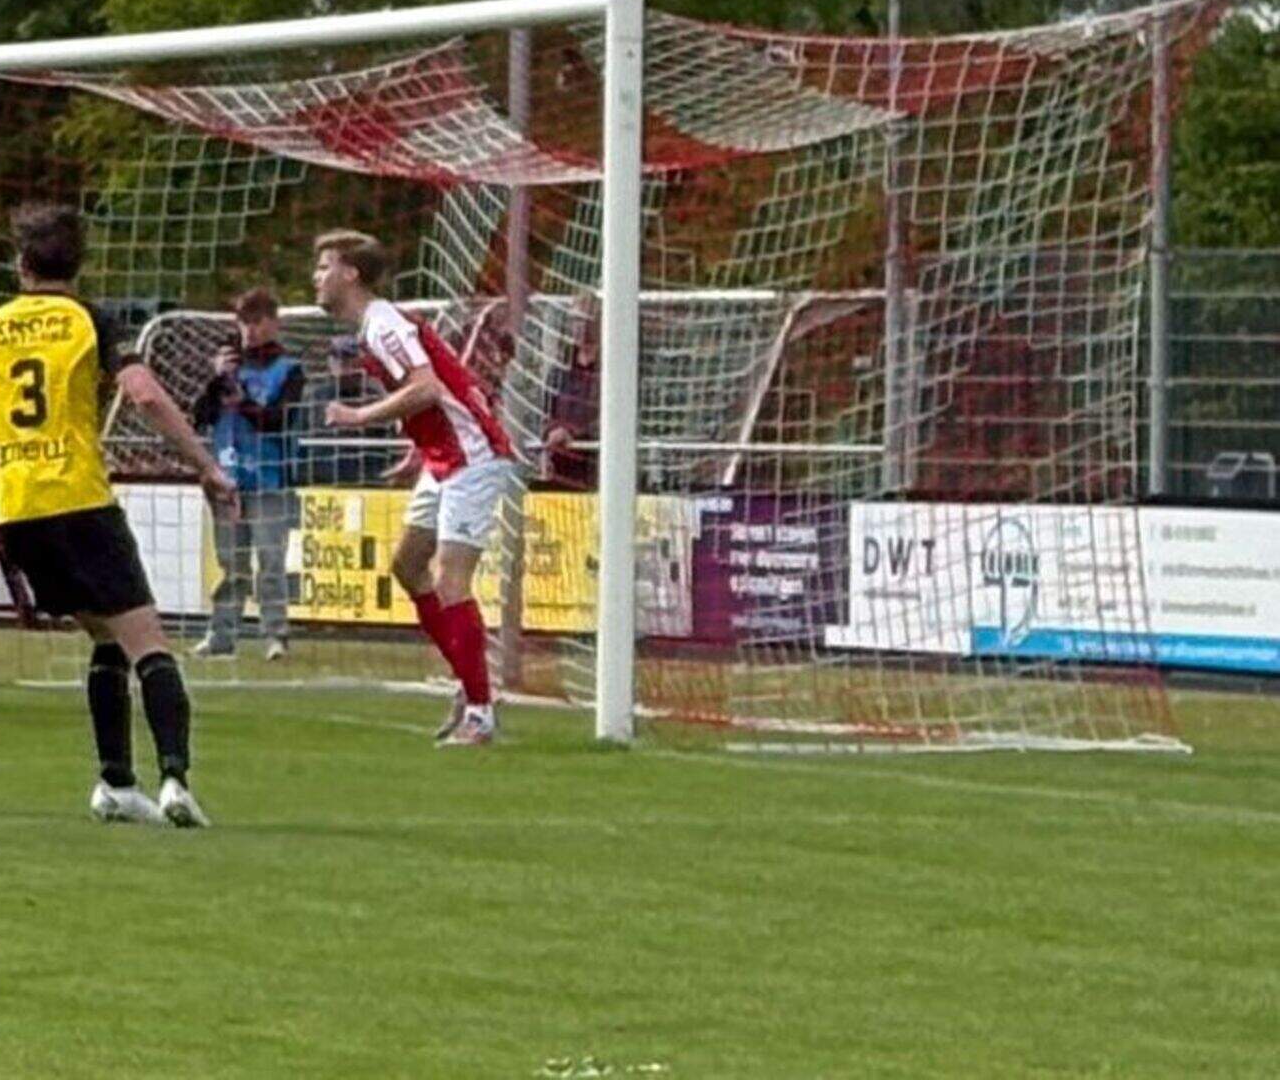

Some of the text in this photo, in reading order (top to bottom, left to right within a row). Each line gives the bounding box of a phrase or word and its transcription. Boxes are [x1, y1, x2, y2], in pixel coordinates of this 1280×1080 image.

[10, 357, 49, 428] 3
[305, 495, 344, 531] Safe
[302, 534, 355, 570] Store
[302, 572, 366, 617] Opslag
